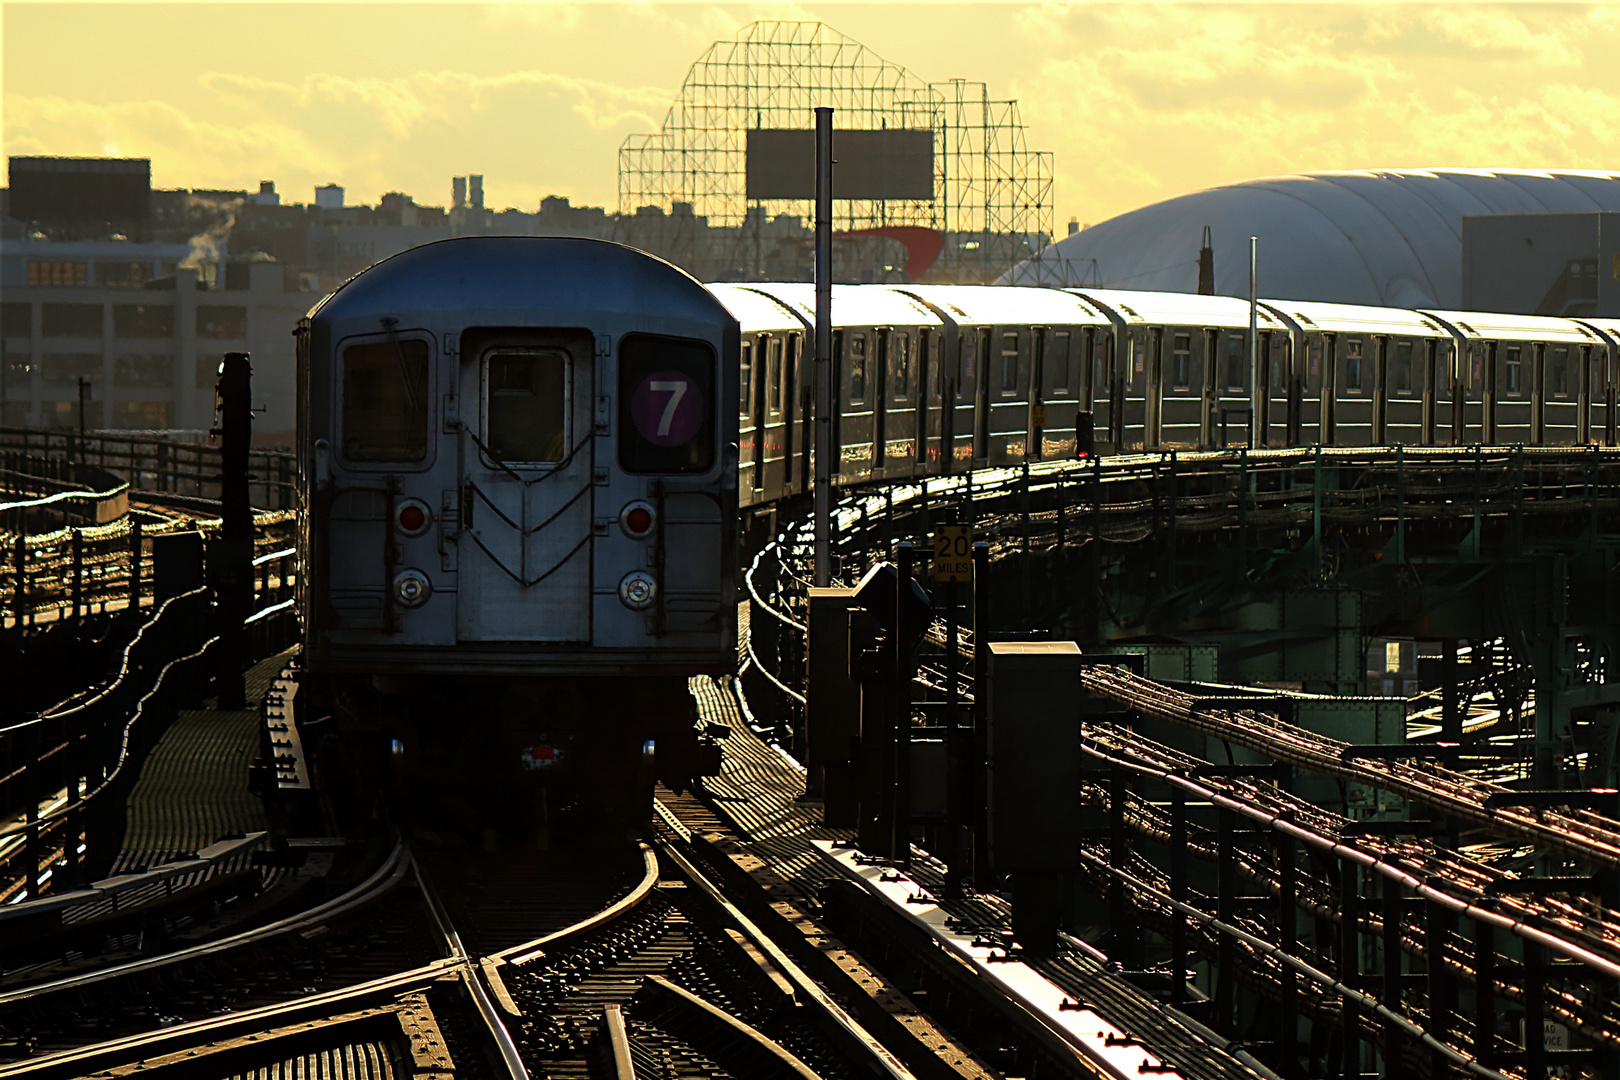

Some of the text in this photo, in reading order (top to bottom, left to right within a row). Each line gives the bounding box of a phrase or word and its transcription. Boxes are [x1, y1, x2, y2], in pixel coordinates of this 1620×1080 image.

[650, 381, 687, 436] 7
[939, 536, 968, 557] 20
[937, 563, 969, 573] MILES
[1544, 1036, 1562, 1046] VICE
